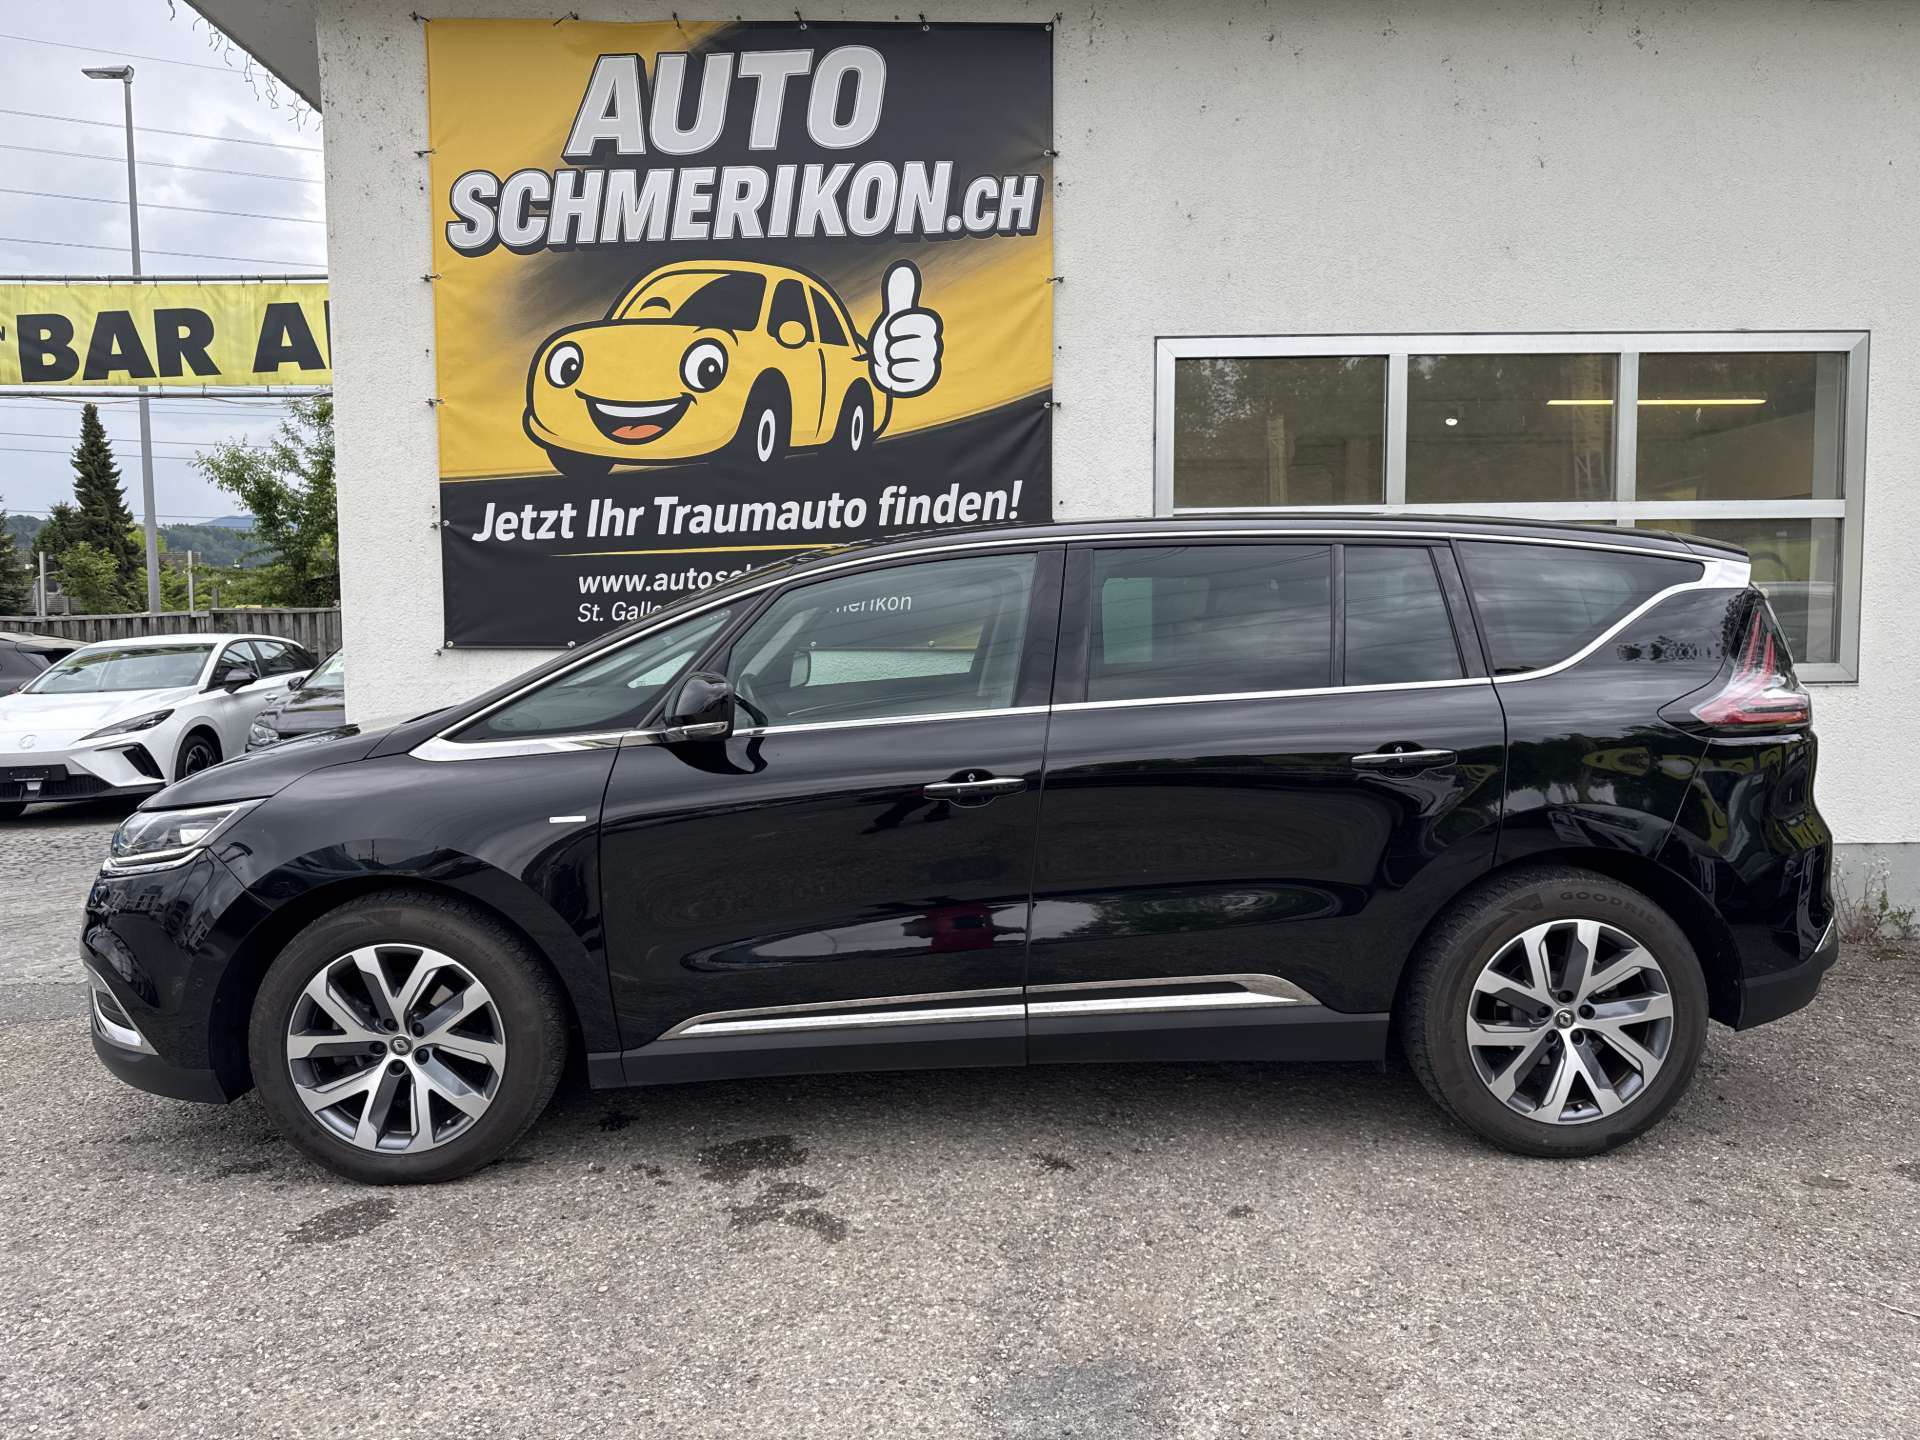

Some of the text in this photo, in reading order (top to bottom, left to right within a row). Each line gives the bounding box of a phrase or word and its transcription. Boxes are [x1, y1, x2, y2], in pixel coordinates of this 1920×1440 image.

[562, 44, 888, 156] AUTO
[446, 161, 1041, 250] SCHMERIKON.CH
[16, 300, 332, 383] BAR A
[472, 480, 1023, 542] Jetzt Ihr Traumauto finden!
[578, 564, 751, 594] www.autos
[578, 602, 604, 622] St.
